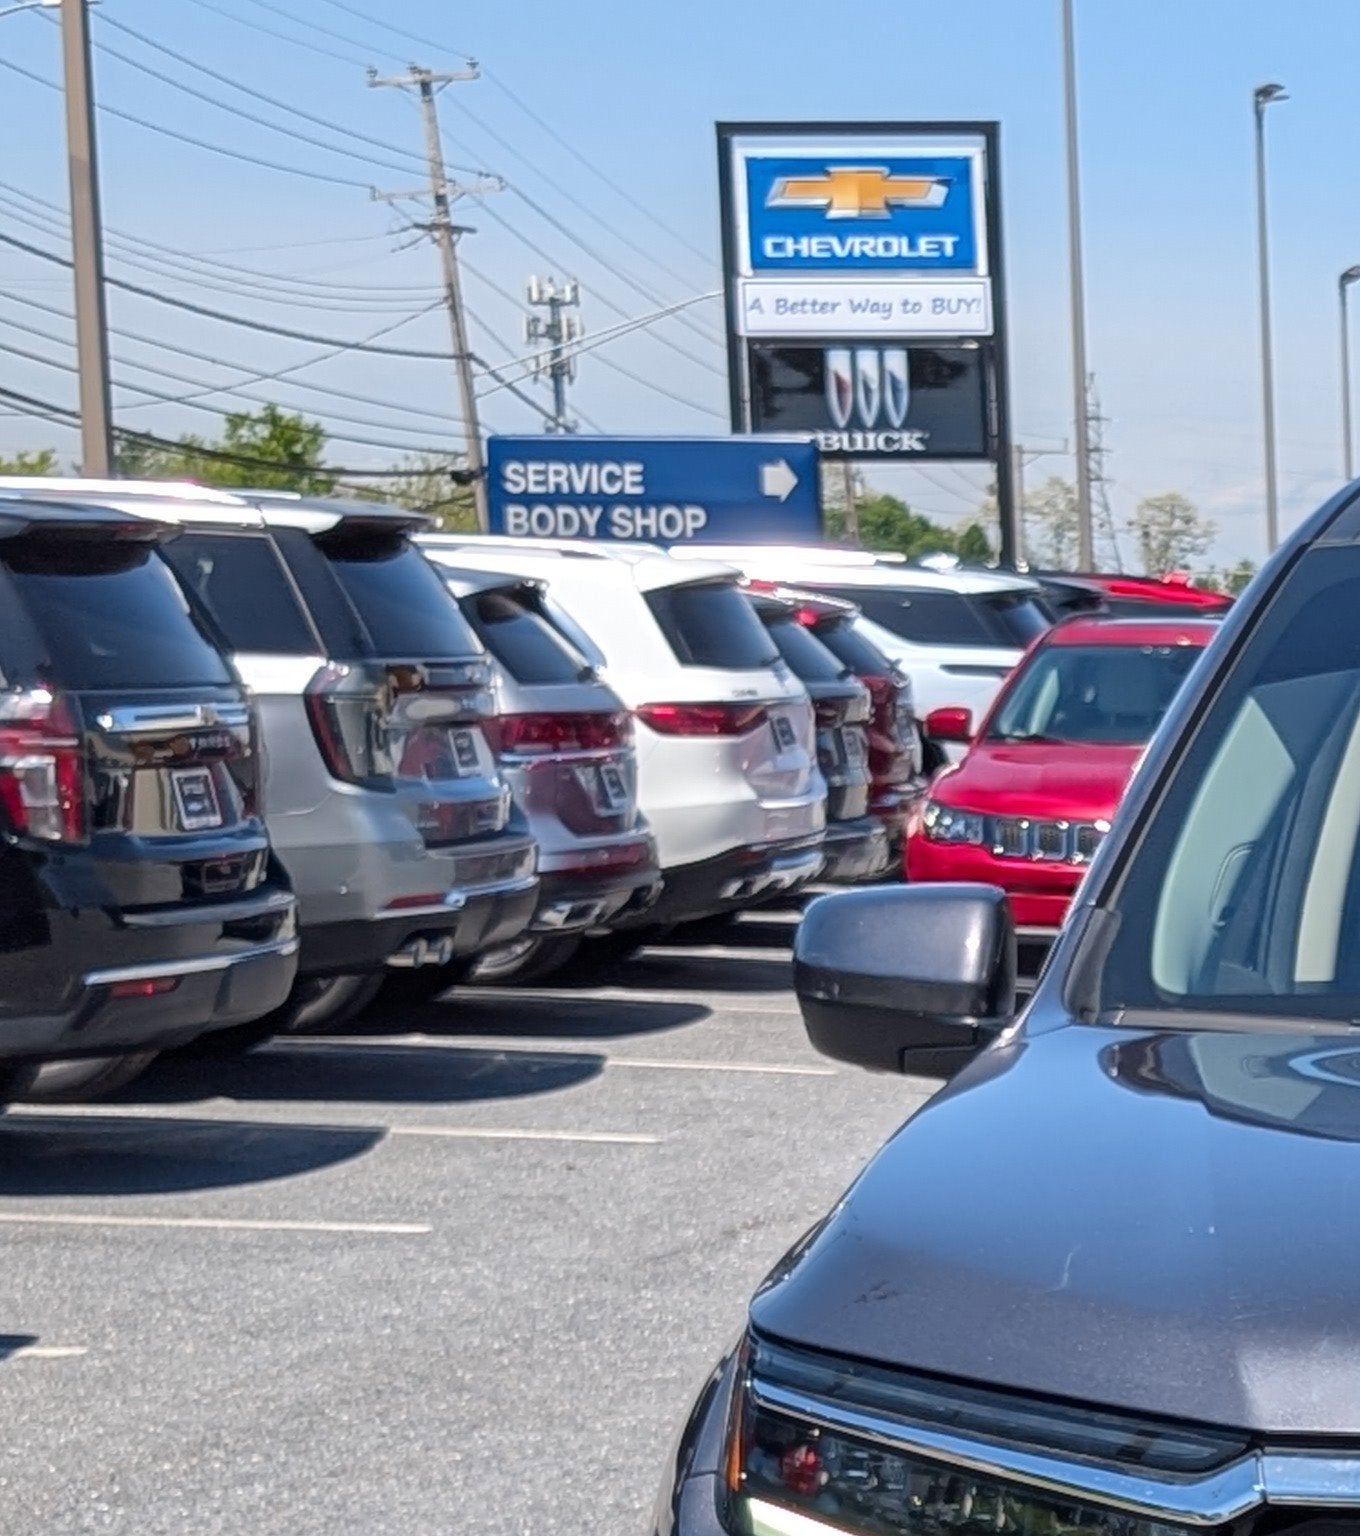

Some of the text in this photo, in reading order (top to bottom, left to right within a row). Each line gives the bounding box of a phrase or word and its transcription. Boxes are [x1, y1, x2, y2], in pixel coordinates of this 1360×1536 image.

[763, 236, 960, 258] CHEVROLET
[749, 298, 982, 320] A Better Way to BUY!
[815, 429, 930, 452] BUICK
[504, 461, 645, 495] SERVICE
[506, 504, 707, 539] BODY SHOP
